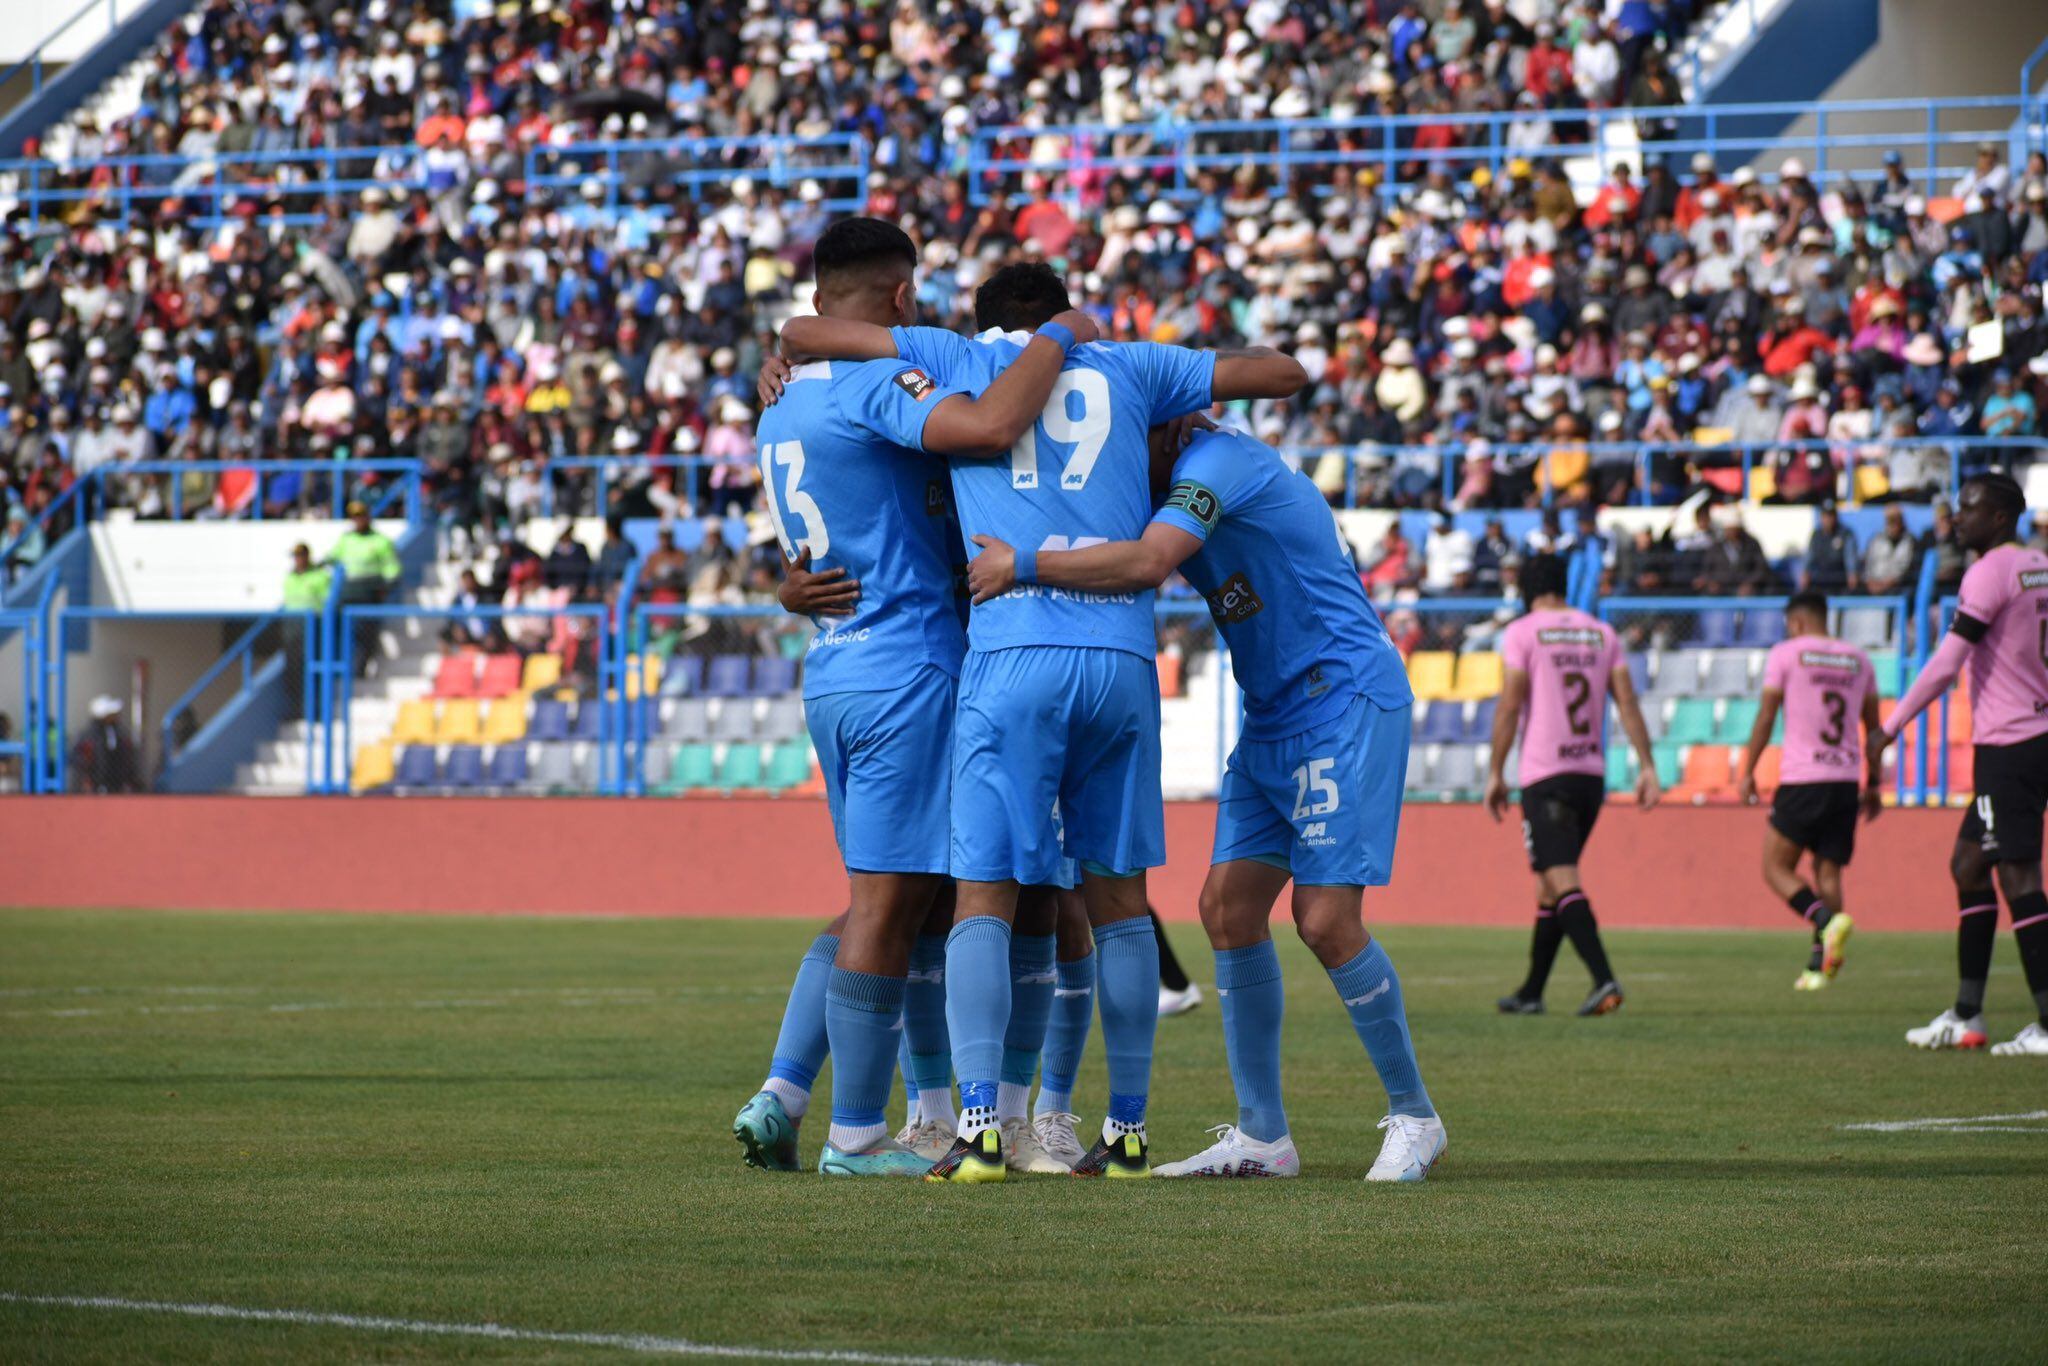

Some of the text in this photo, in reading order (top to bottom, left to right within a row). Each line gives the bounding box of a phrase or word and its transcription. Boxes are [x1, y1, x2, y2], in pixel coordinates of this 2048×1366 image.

[761, 439, 829, 563] 13
[1563, 671, 1590, 735] 2
[1820, 691, 1847, 747] 3
[1291, 757, 1339, 821] 25
[1977, 795, 1994, 831] 4
